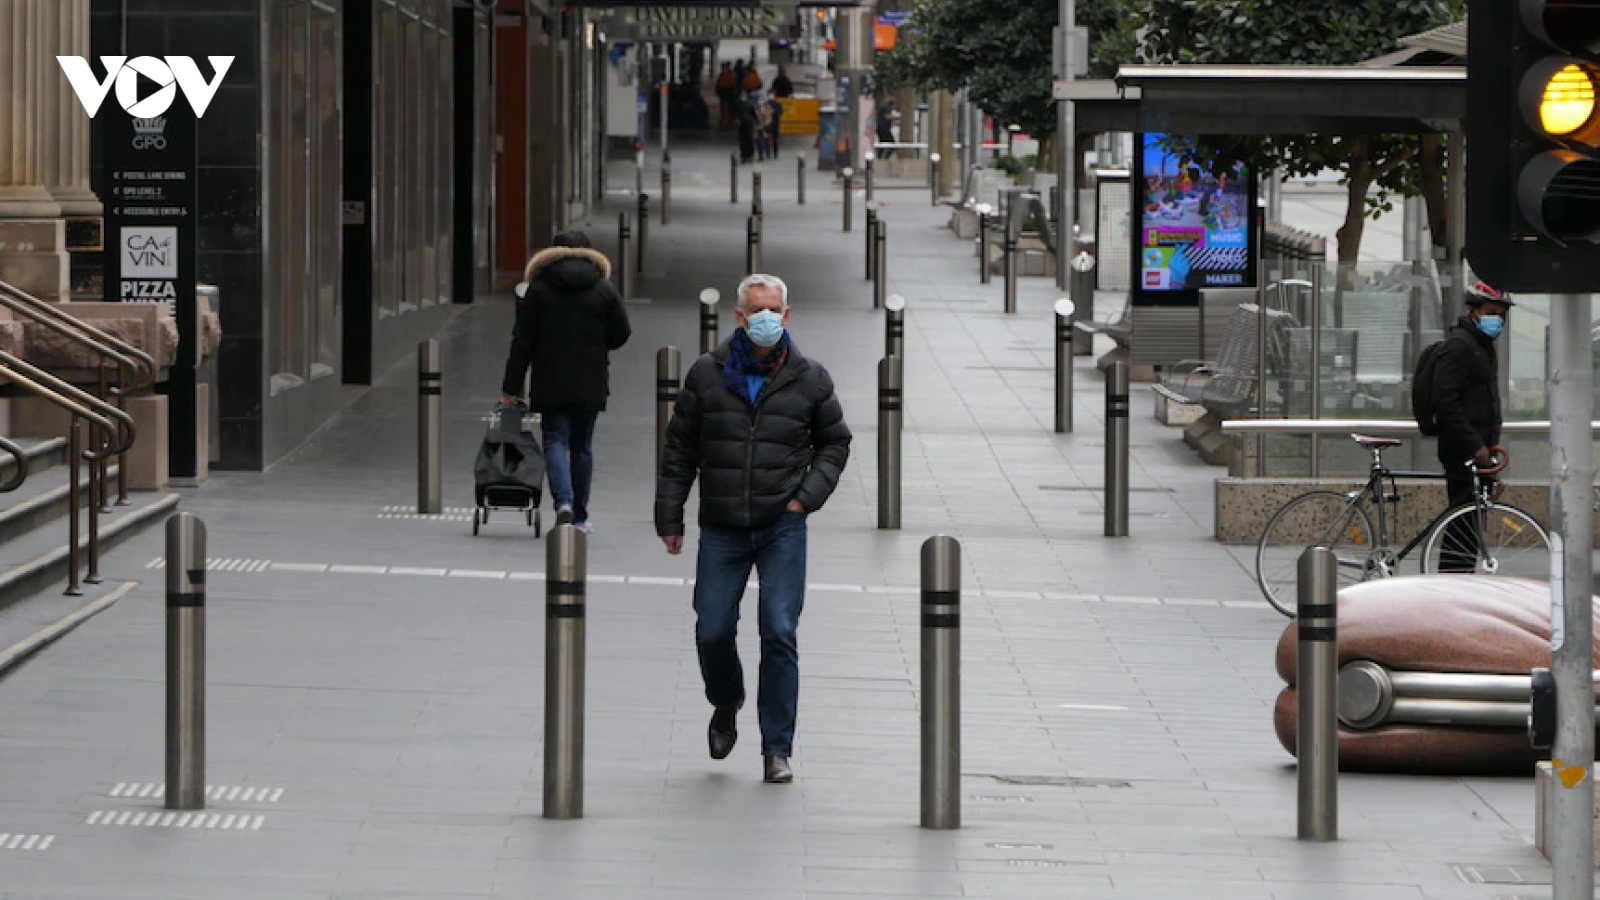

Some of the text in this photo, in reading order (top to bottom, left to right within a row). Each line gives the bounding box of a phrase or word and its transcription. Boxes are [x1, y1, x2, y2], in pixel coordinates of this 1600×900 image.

[636, 6, 776, 22] DAVID JONES
[706, 25, 778, 36] JONES
[132, 136, 167, 150] GPO
[137, 186, 155, 195] LEVEL
[1210, 233, 1242, 243] MUSIC
[1206, 275, 1242, 283] MAKER
[120, 281, 176, 297] PIZZA
